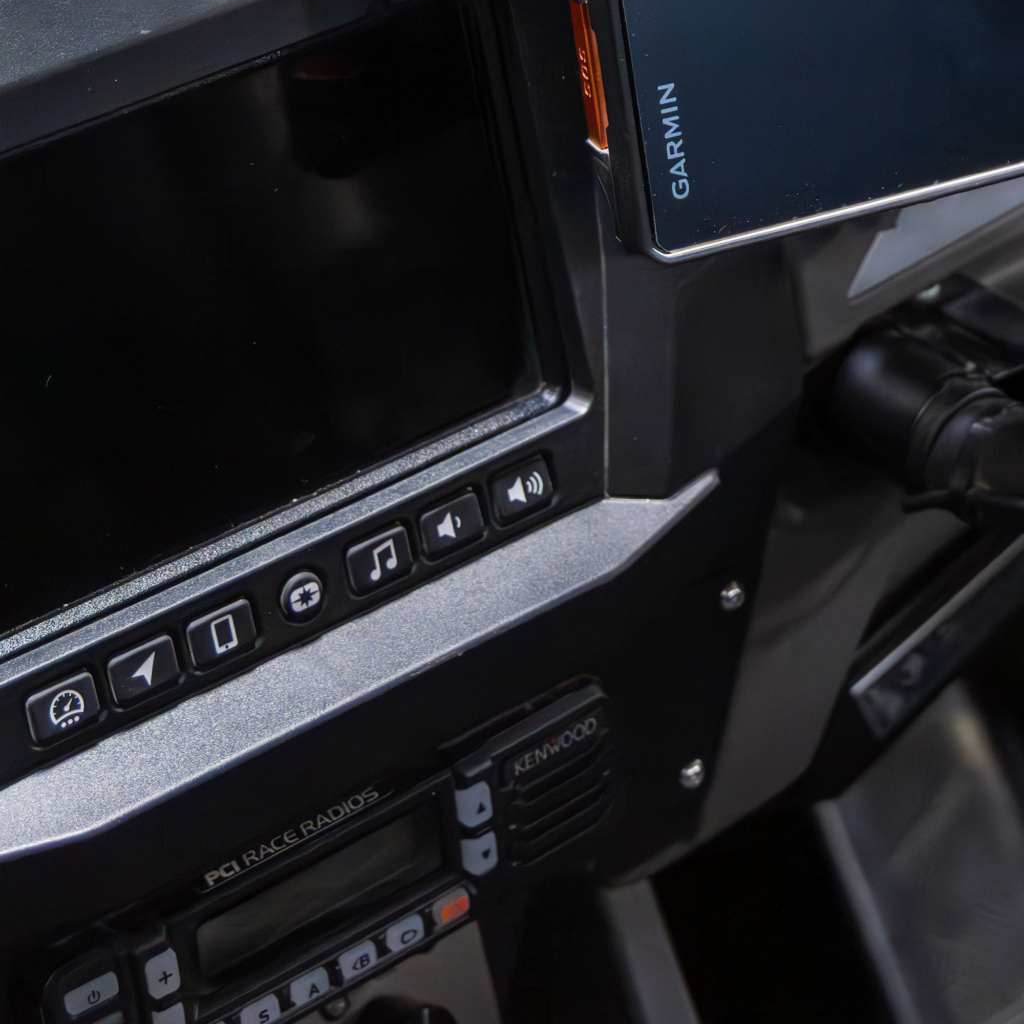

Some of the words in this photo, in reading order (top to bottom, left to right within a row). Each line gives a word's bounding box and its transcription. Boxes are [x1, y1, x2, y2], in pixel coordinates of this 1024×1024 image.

[656, 82, 690, 200] GARMIN
[514, 717, 598, 776] KENWOOD
[204, 860, 241, 886] PCI
[242, 830, 300, 866] RACE
[300, 786, 380, 836] RADIOS
[257, 1008, 271, 1024] S
[308, 983, 320, 998] A
